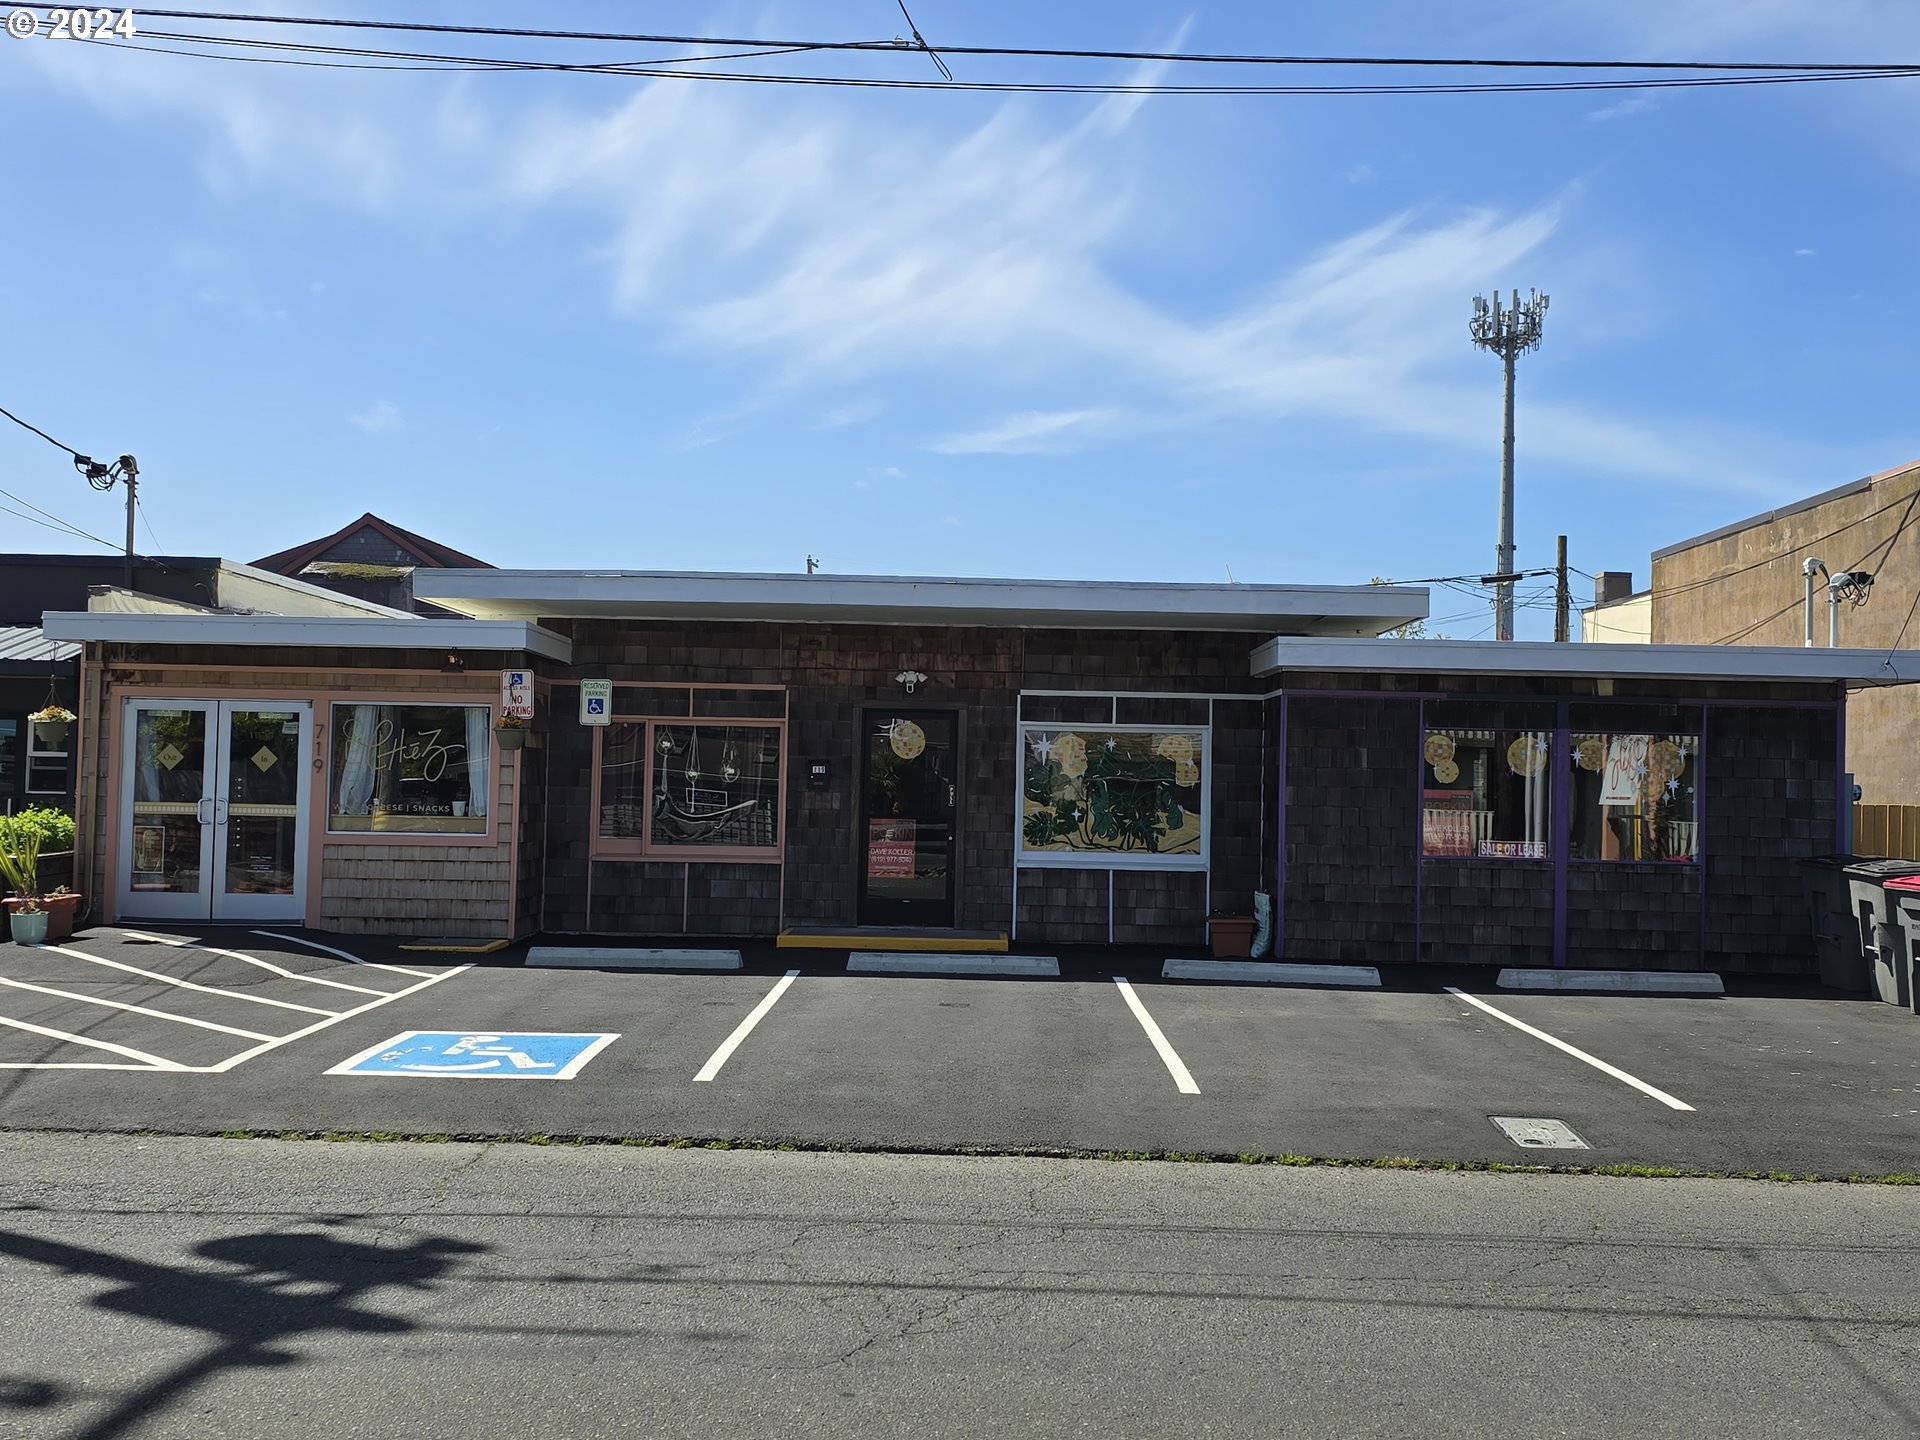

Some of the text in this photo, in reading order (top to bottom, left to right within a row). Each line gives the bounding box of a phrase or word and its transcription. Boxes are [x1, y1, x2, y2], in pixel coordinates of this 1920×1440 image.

[583, 682, 610, 690] RESERVED
[511, 695, 523, 704] NO
[503, 705, 531, 716] PARKING
[313, 723, 325, 774] 719
[163, 754, 177, 762] Out
[412, 804, 450, 813] SNACKS
[1481, 842, 1503, 855] SALE
[1504, 843, 1517, 856] OR
[1518, 843, 1544, 857] LEASE
